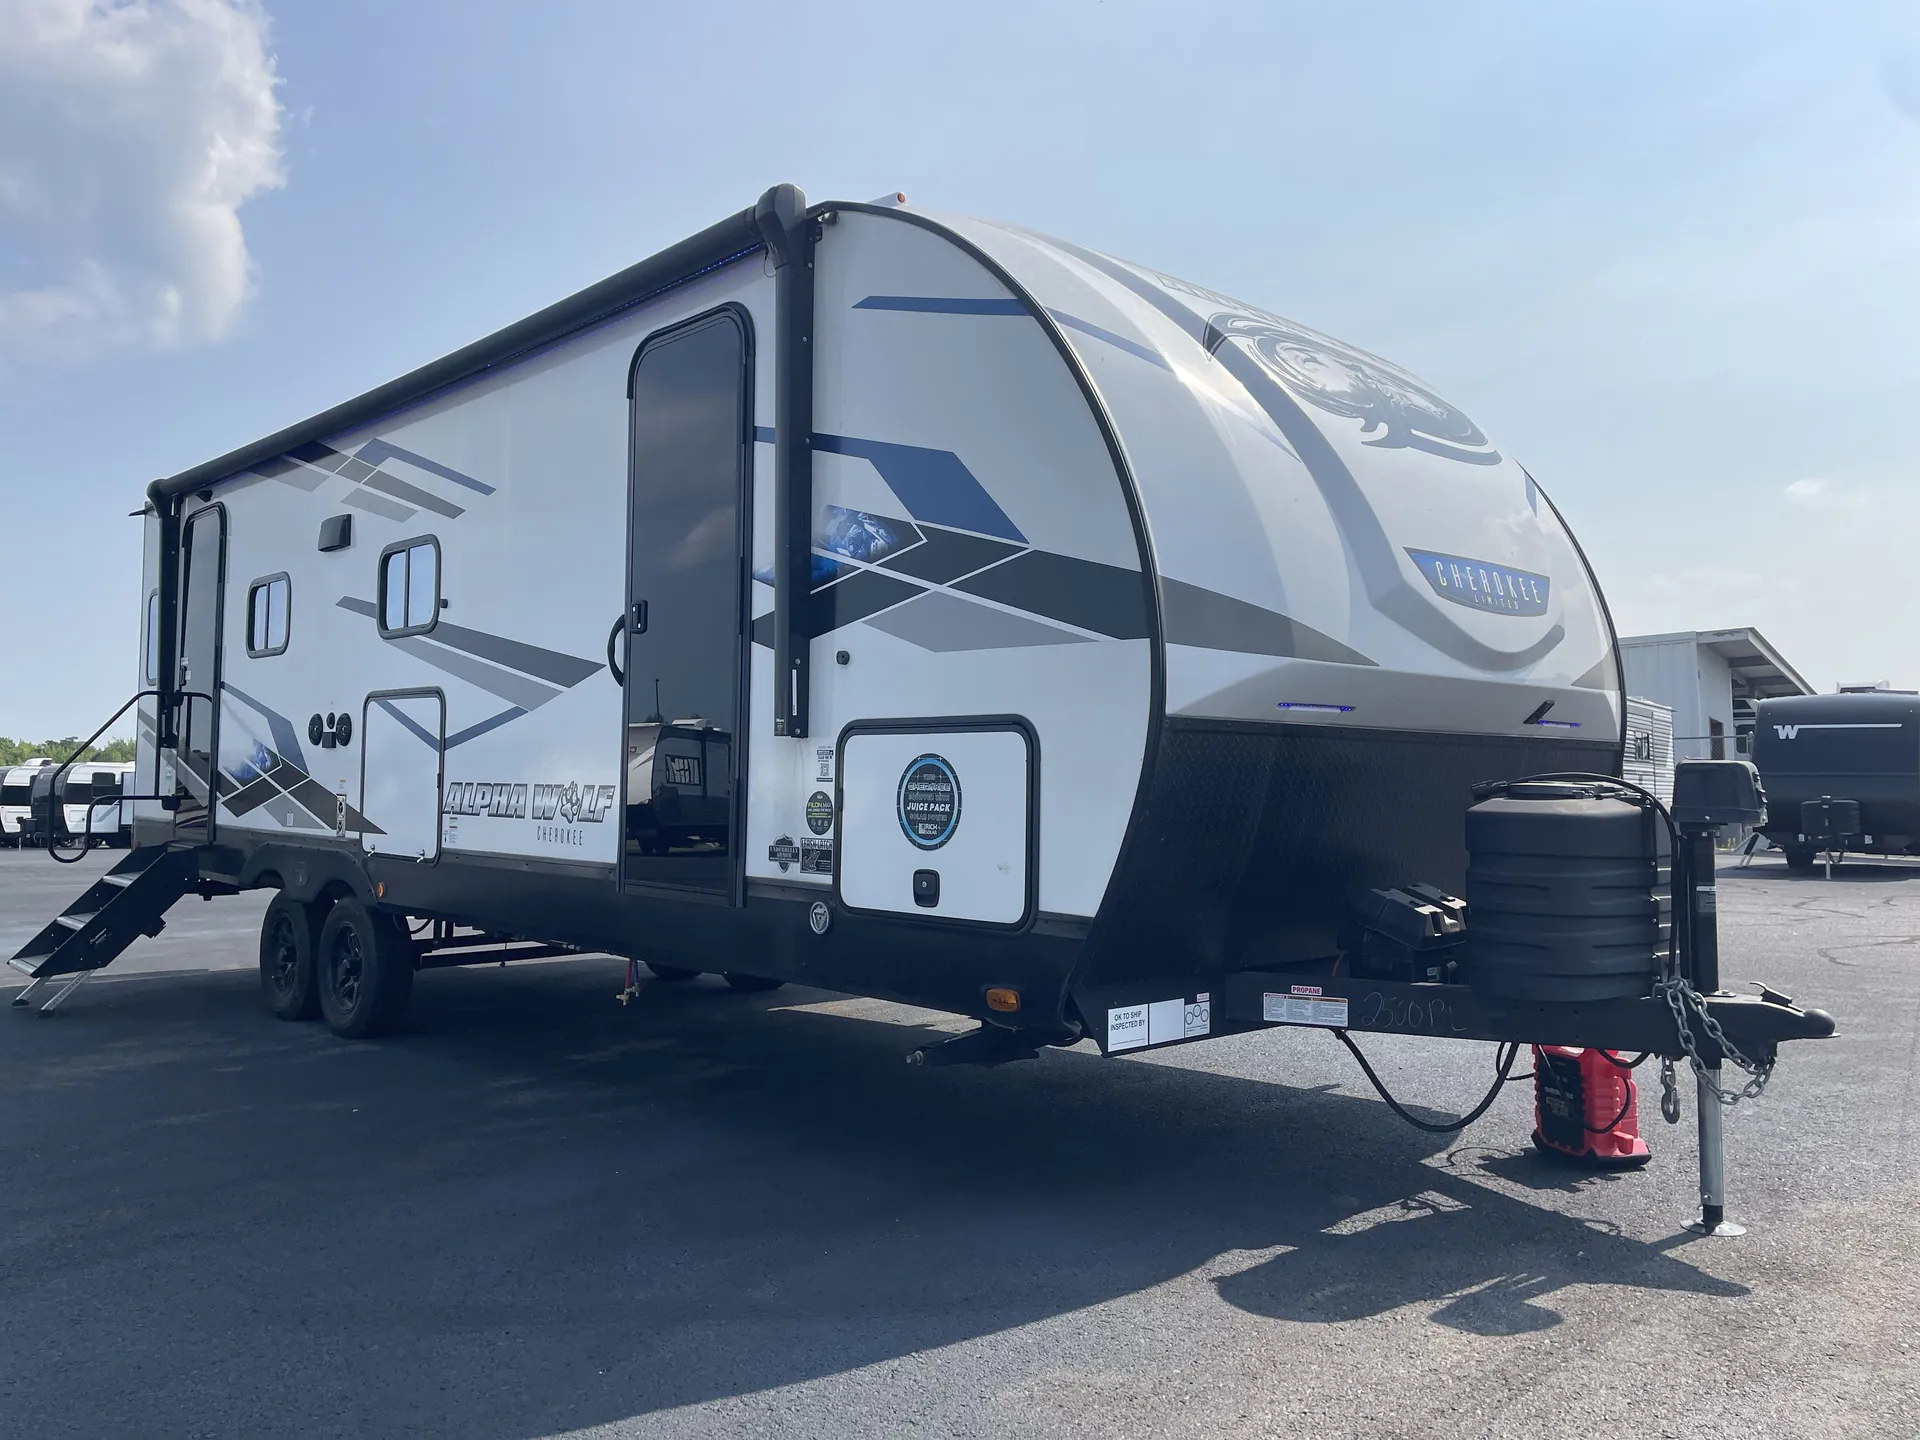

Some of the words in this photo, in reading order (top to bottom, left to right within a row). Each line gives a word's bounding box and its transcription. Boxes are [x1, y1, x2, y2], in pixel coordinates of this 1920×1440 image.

[1435, 561, 1542, 604] CHEROKEE
[1474, 594, 1519, 610] LIMITED
[442, 782, 528, 819] ALPHA
[907, 803, 928, 811] JUICE
[929, 803, 951, 812] PACK
[536, 825, 583, 846] CHEROKEE
[1292, 986, 1321, 995] PROPANE
[1114, 1013, 1122, 1021] OK
[1123, 1012, 1130, 1020] TO
[1130, 1010, 1142, 1019] SHIP
[1110, 1021, 1138, 1031] INSPECTED
[1138, 1019, 1146, 1027] BY
